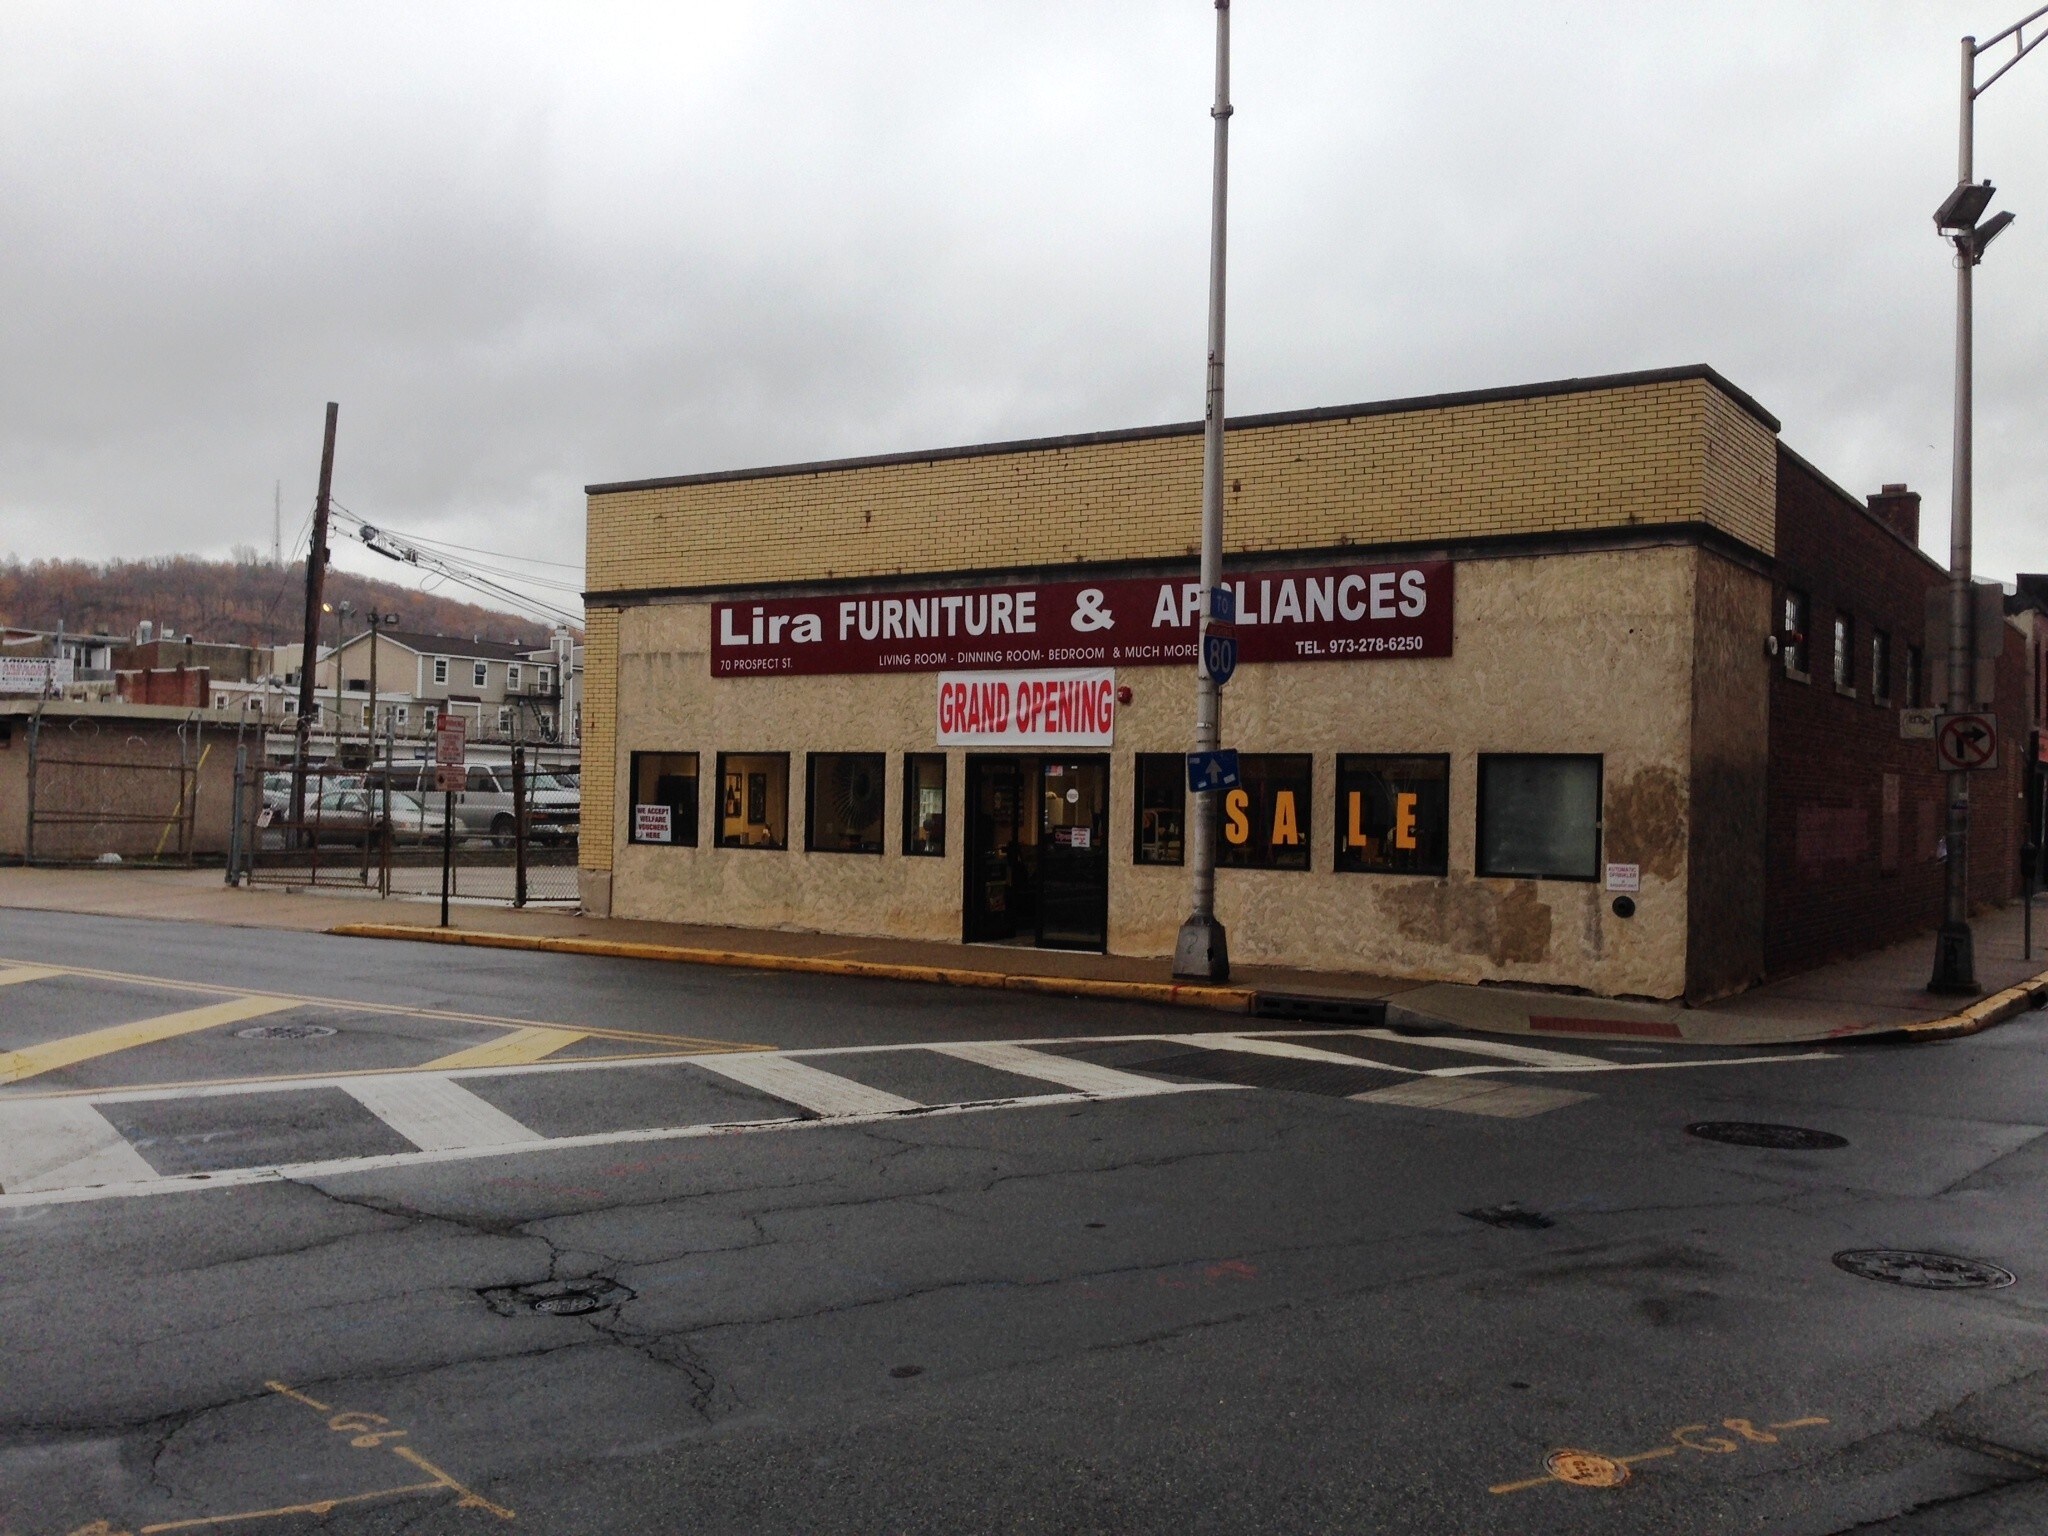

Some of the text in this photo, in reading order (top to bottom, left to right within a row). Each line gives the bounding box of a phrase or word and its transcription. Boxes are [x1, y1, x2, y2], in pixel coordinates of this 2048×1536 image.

[720, 570, 1427, 646] Lira FURNITURE & APLIANCES
[879, 654, 911, 666] LIVING
[914, 653, 947, 665] ROOM
[957, 651, 1003, 663] DINNING
[1048, 647, 1105, 660] BEDROOM
[1113, 646, 1121, 658] &
[1125, 645, 1160, 658] MUCH
[1164, 644, 1198, 657] MORE
[1210, 639, 1232, 673] 80
[1295, 636, 1423, 654] TEL. 973-278-6250
[720, 660, 731, 671] 70
[734, 658, 778, 670] PROSPECT
[940, 680, 1112, 733] GRAND OPENING
